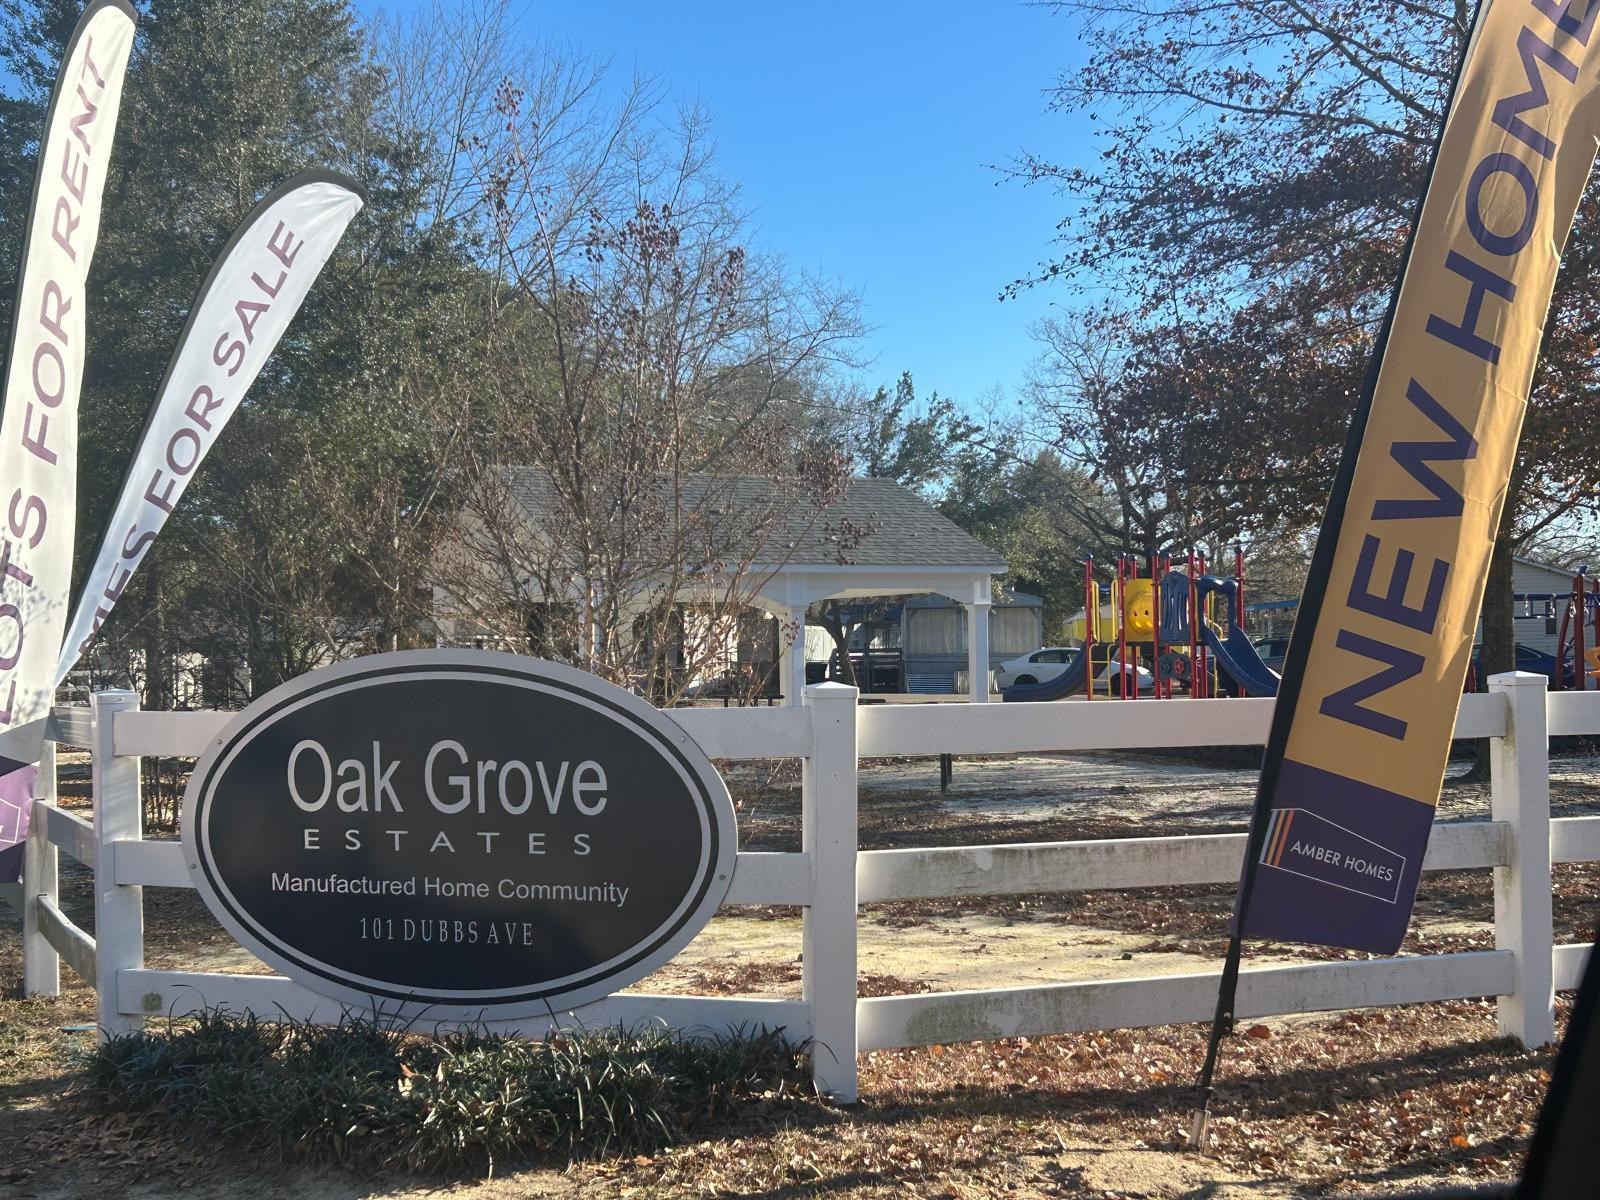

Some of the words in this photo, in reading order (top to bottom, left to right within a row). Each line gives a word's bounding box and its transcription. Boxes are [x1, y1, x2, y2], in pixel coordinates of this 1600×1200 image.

[21, 279, 73, 466] FOR
[51, 34, 106, 263] RENT
[143, 385, 225, 515] FOR
[213, 220, 304, 377] SALE
[1319, 377, 1479, 741] NEW
[287, 739, 404, 813] Oak
[424, 739, 608, 817] Grove
[303, 828, 592, 856] ESTATES
[1290, 840, 1341, 866] AMBER
[1344, 855, 1394, 881] HOMES
[271, 872, 416, 896] Manufactured
[424, 877, 490, 898] Home
[498, 879, 630, 908] Community
[359, 917, 394, 940] 101
[403, 919, 478, 943] DUBBS
[487, 922, 533, 946] AVE
